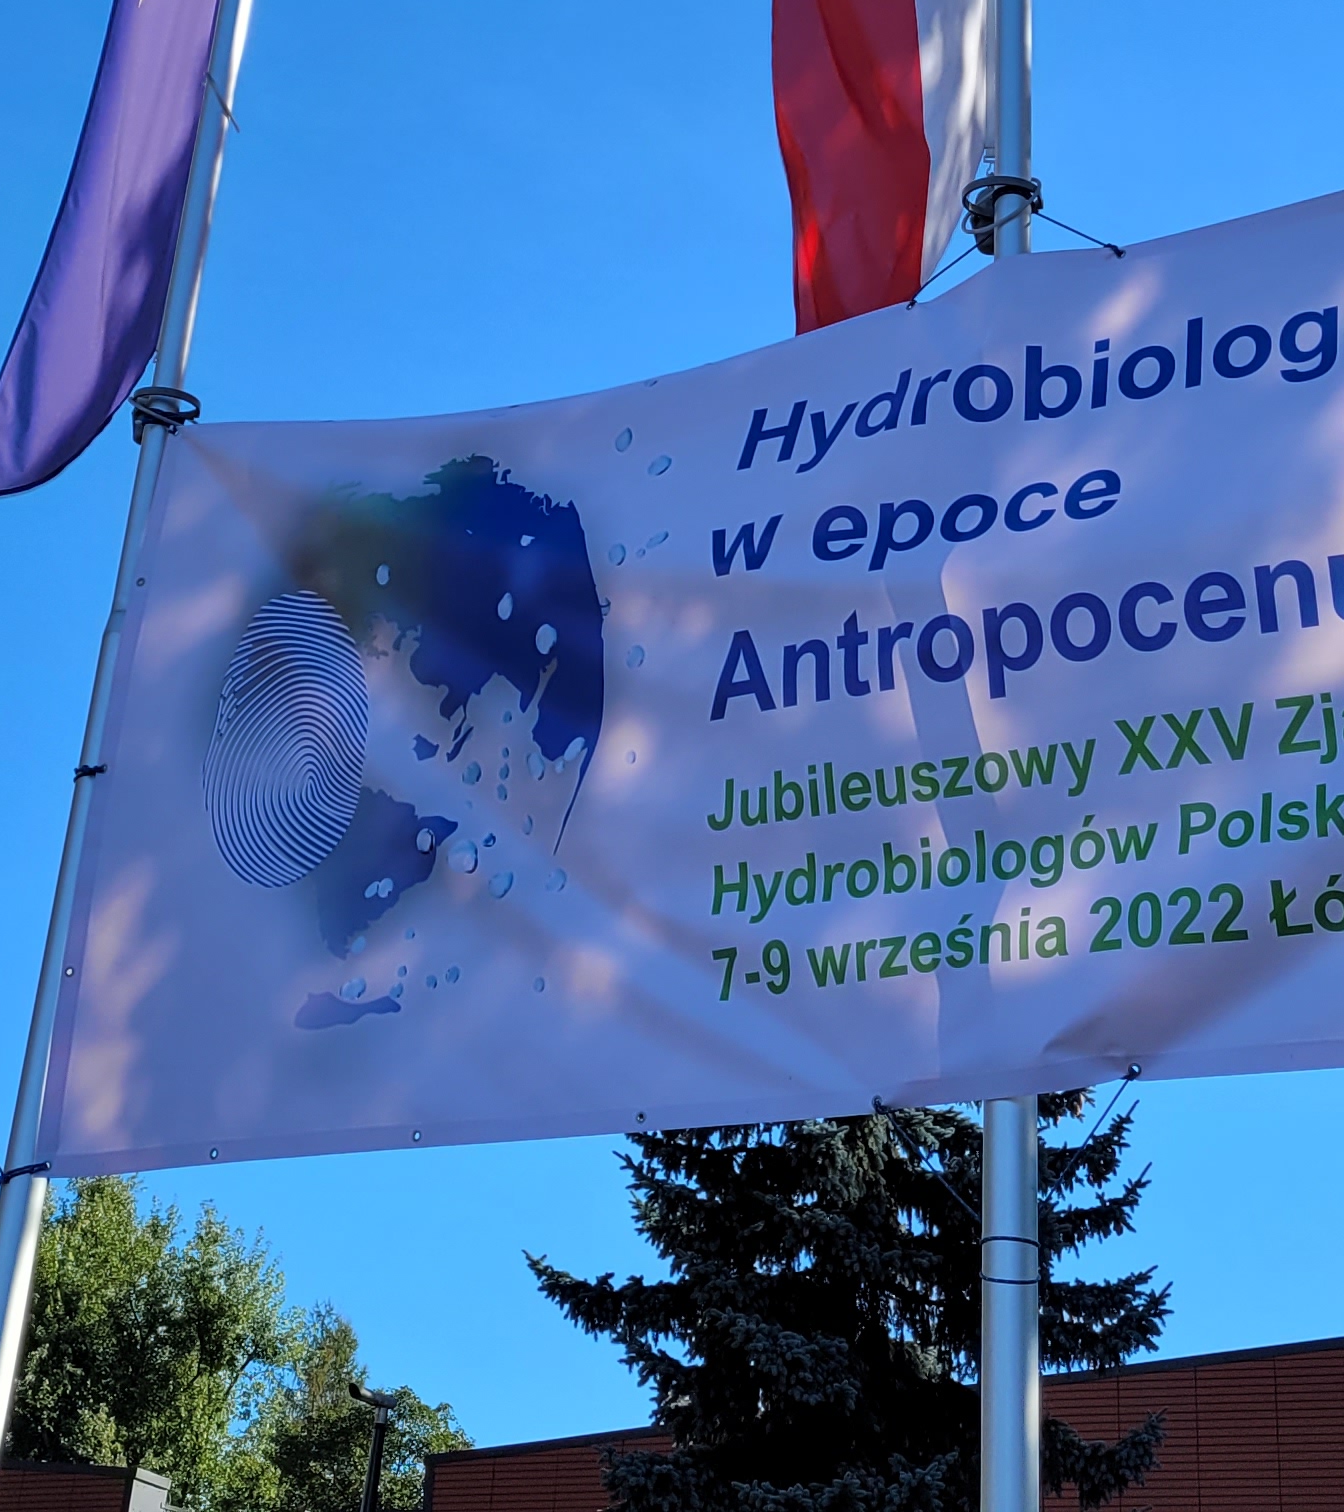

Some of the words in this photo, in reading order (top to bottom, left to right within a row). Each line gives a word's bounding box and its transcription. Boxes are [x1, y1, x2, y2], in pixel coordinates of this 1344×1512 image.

[711, 513, 783, 577] w
[811, 466, 1122, 571] epoce
[707, 737, 1096, 831] Jubileuszowy
[1114, 702, 1255, 775] XXV
[711, 816, 1159, 924] Hydrobiologów
[712, 940, 791, 1002] 7-9
[808, 911, 1067, 989] września
[1089, 883, 1248, 953] 2022
